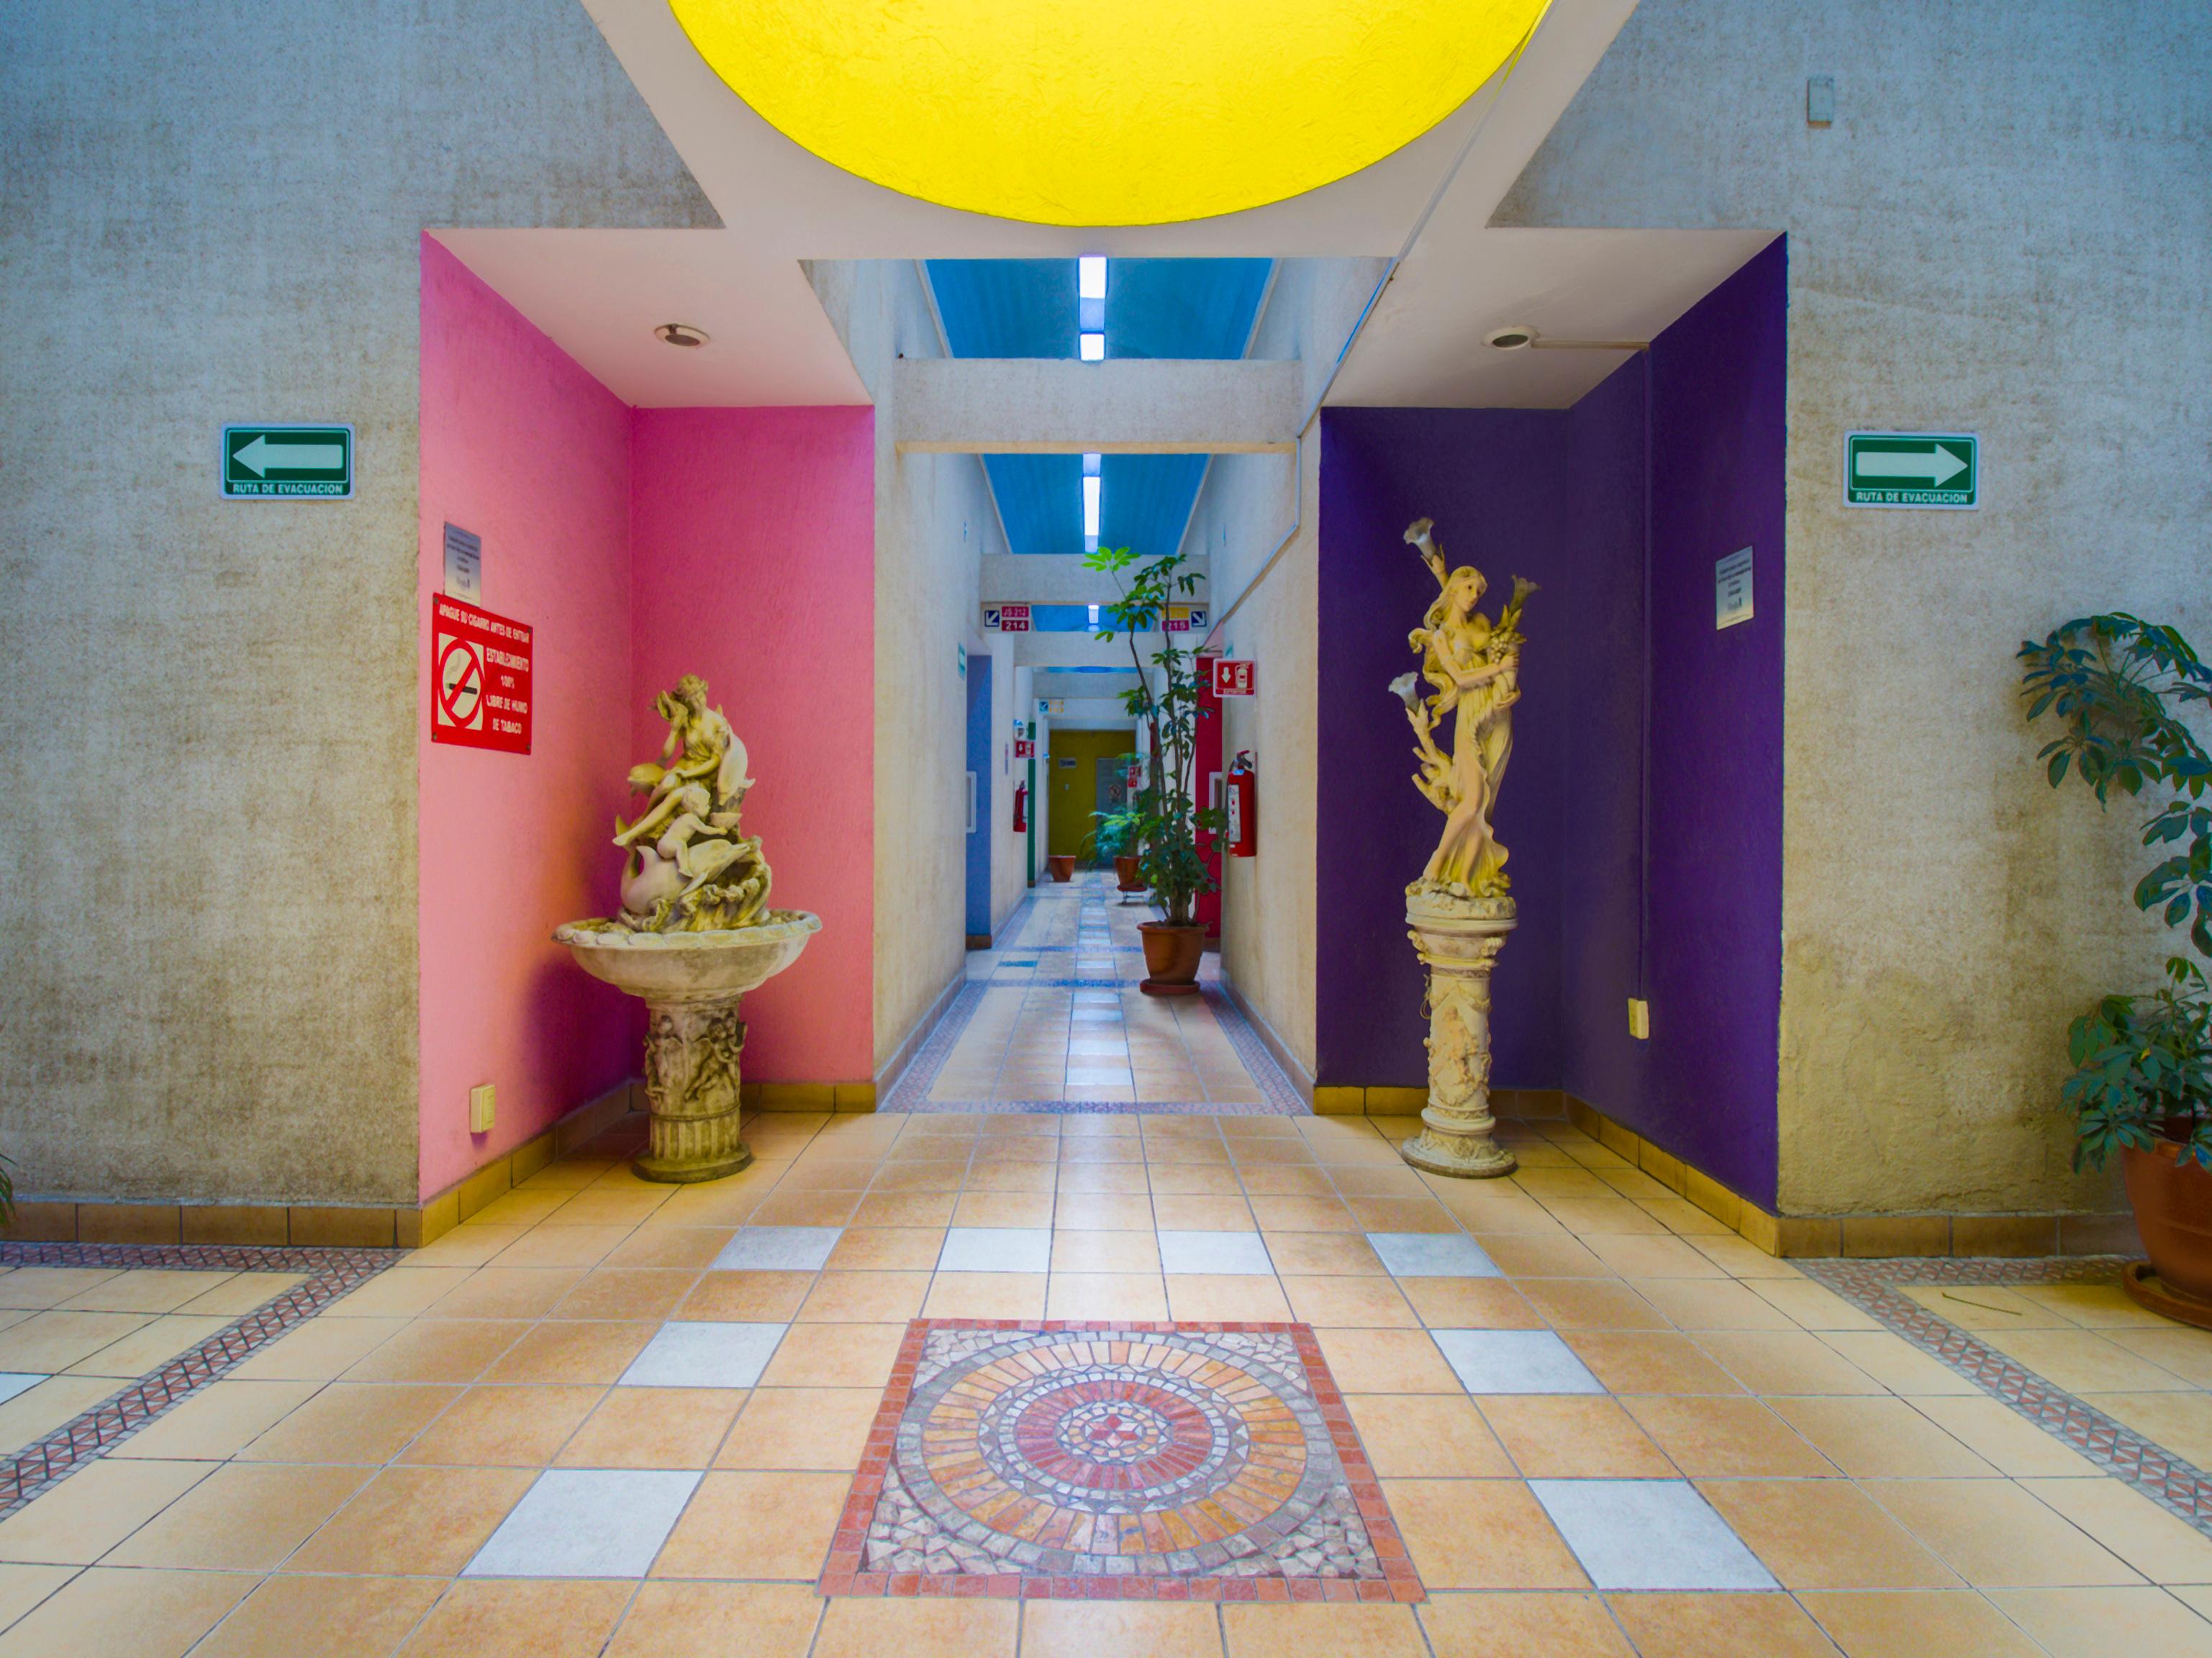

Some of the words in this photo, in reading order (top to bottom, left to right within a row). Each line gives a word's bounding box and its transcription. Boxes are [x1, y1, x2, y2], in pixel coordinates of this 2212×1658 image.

[233, 484, 259, 493] RUTA
[262, 484, 275, 493] DE
[278, 484, 343, 494] EVACUACION
[1856, 492, 1882, 502] RUTA
[1885, 492, 1899, 502] DE
[1902, 493, 1968, 503] EVACUACION
[439, 603, 460, 622] APAGUE
[461, 610, 468, 625] SU
[491, 621, 505, 636] ANTES
[506, 626, 512, 638] DE
[486, 694, 503, 709] LIBRE
[504, 698, 510, 710] DE
[493, 718, 499, 731] DE
[501, 720, 522, 735] TABACO
